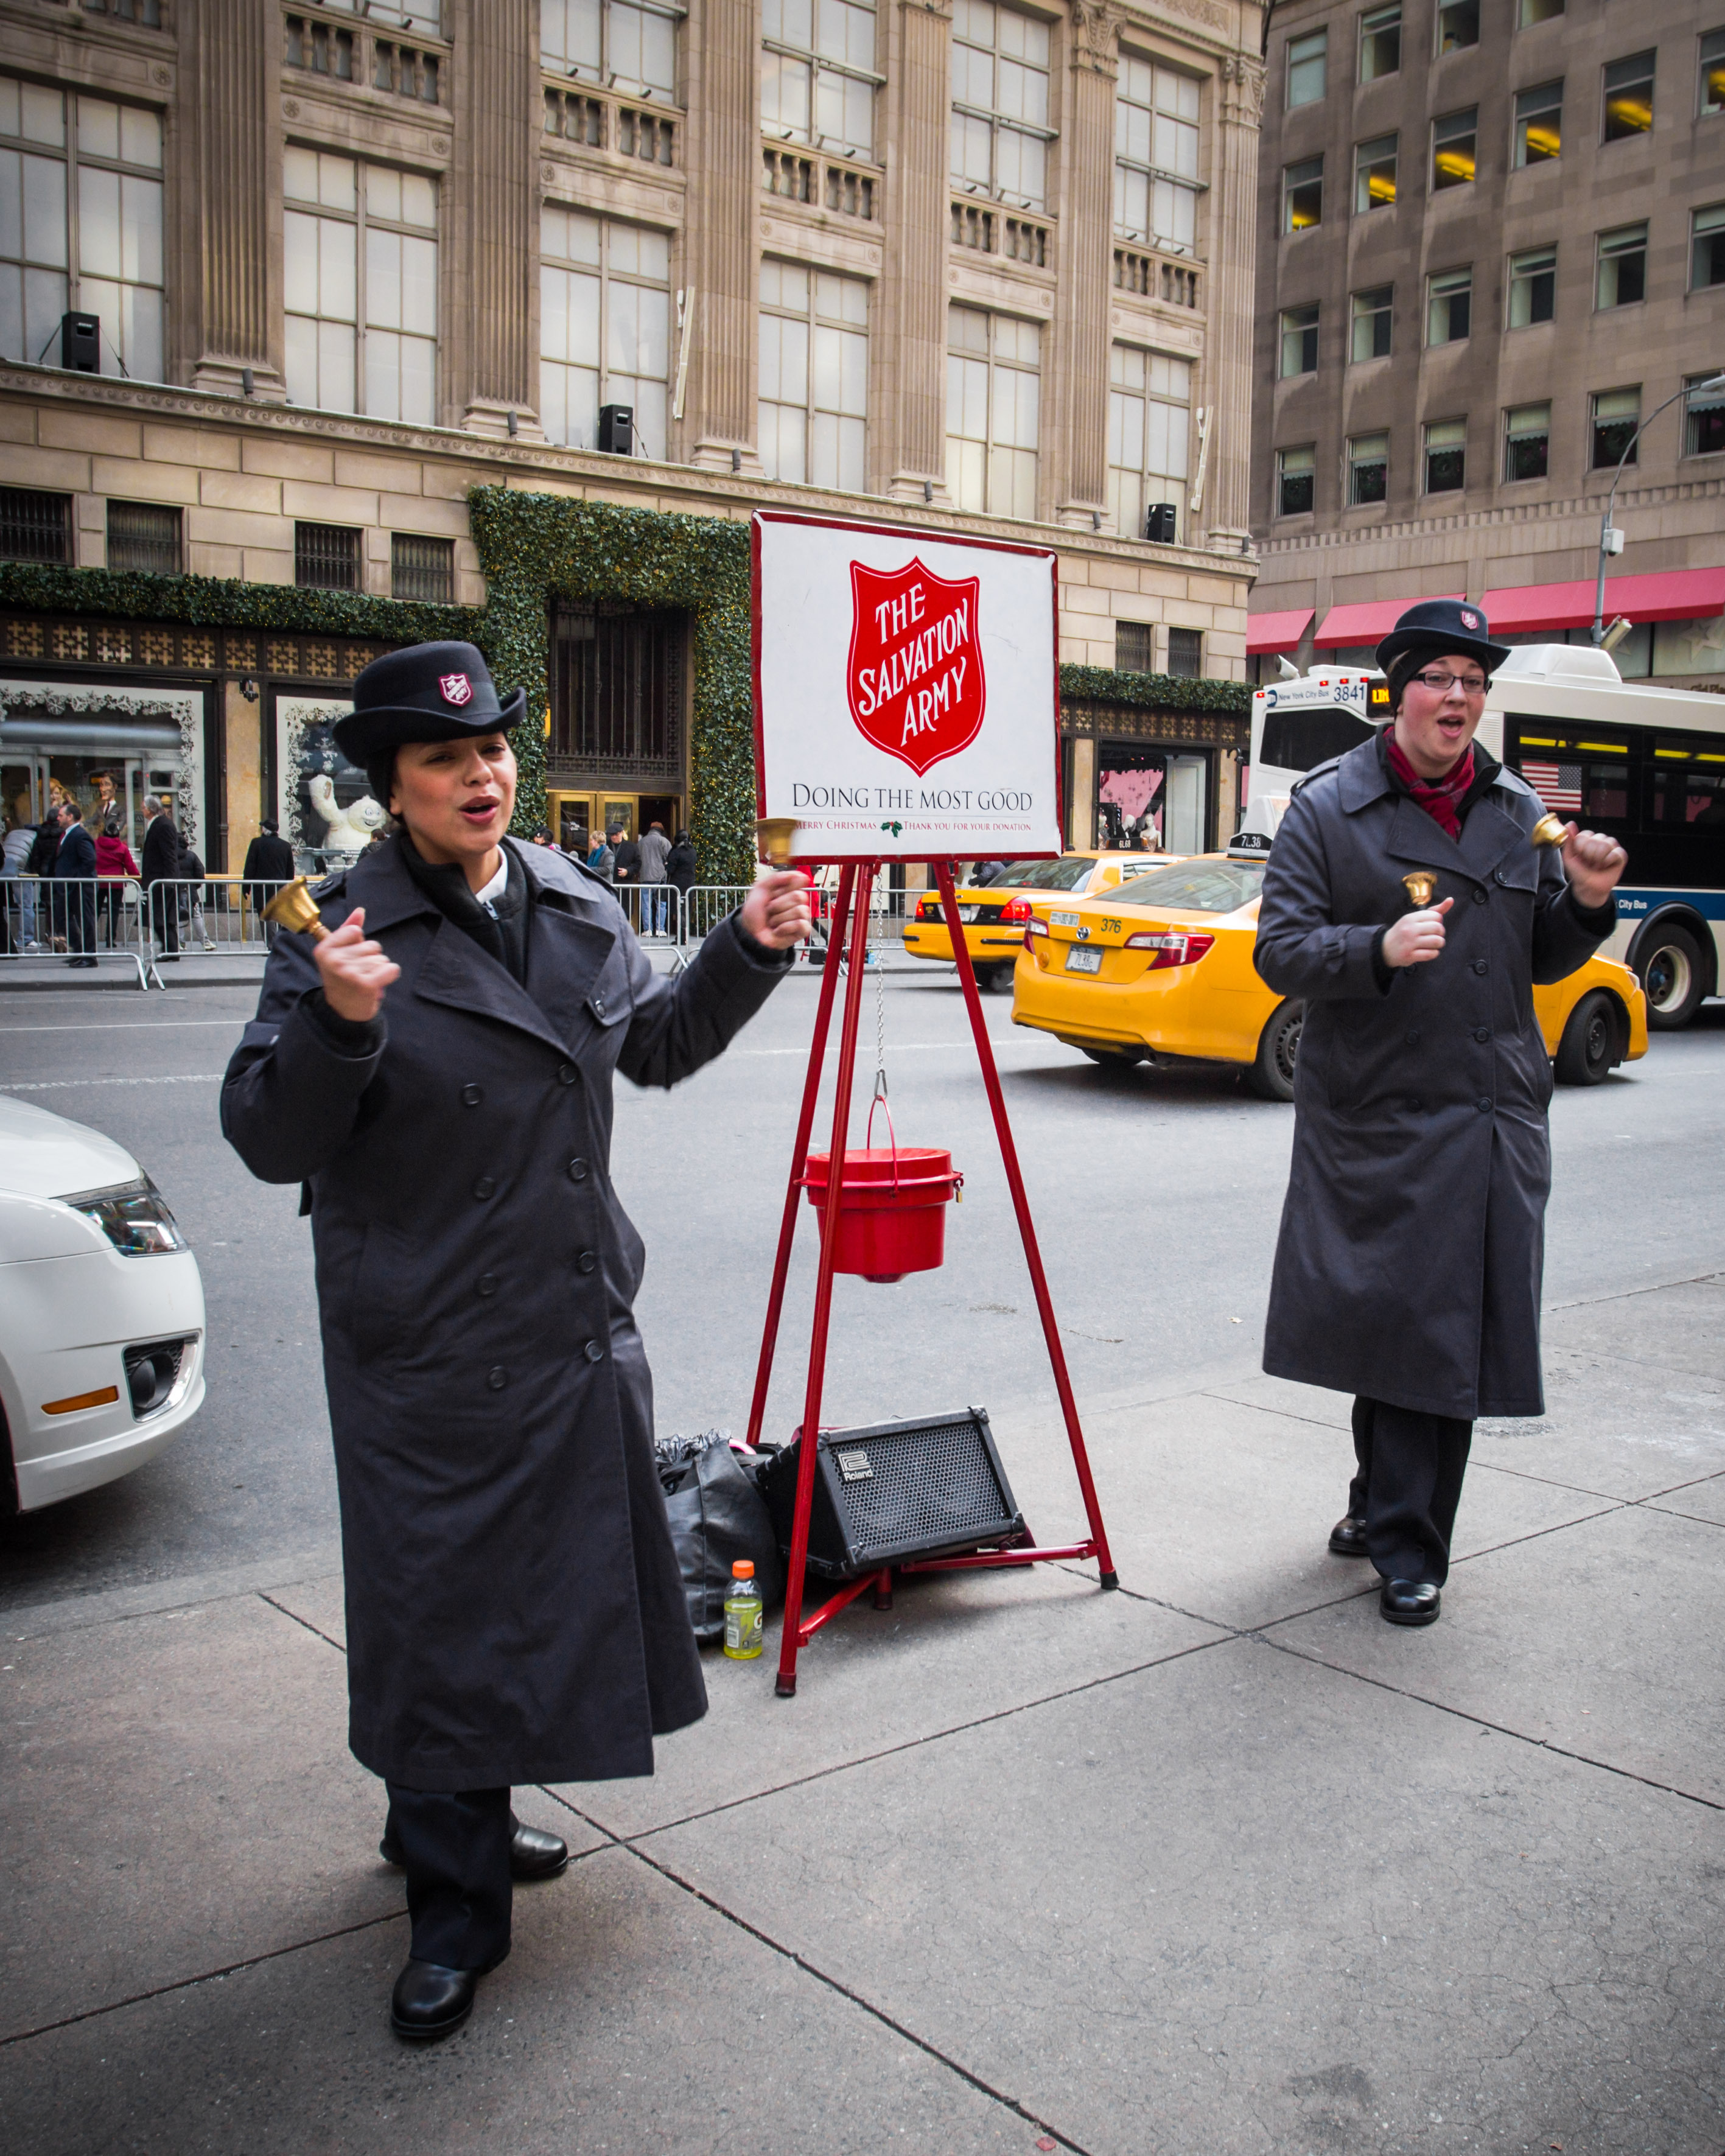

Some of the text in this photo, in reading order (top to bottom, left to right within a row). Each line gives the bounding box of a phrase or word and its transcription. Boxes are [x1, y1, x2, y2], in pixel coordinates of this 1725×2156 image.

[875, 583, 926, 645] THE
[858, 598, 969, 716] SALVATION
[901, 656, 967, 747] ARMY
[1305, 690, 1317, 699] City
[1334, 685, 1365, 702] 3841
[793, 783, 1032, 811] DOING THE MOST GOOD
[903, 821, 932, 831] THANK
[935, 822, 951, 831] YOU
[953, 822, 968, 831] FOR
[971, 822, 990, 831] YOUR
[1618, 899, 1632, 910] City
[1634, 900, 1648, 909] Bus
[1100, 918, 1122, 934] 376
[844, 1468, 874, 1482] Roland
